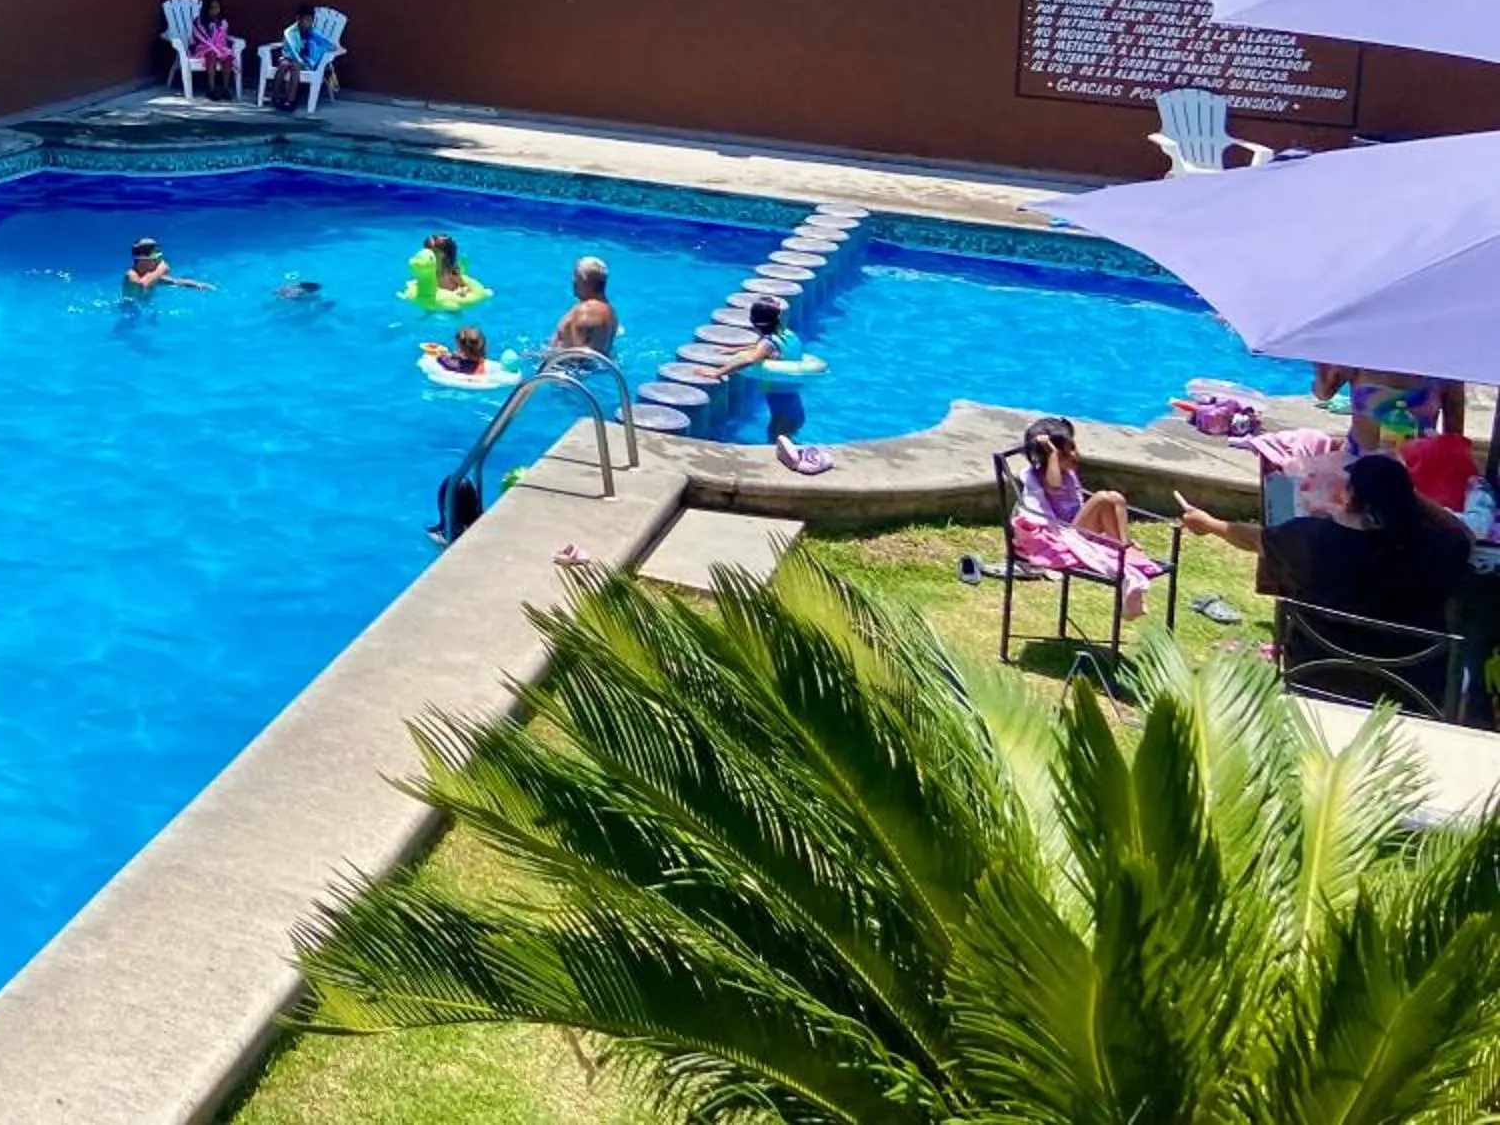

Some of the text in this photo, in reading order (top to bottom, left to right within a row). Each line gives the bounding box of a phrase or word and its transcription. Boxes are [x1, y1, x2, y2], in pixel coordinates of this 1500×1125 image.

[1033, 15, 1053, 26] NO
[1132, 23, 1199, 38] INFLABLES
[1199, 29, 1211, 40] A
[1212, 30, 1230, 42] LA
[1236, 31, 1298, 46] ALBERCA
[1034, 4, 1057, 16] POR
[1060, 6, 1106, 20] HIGIENE
[1111, 10, 1146, 22] USAR
[1151, 13, 1195, 26] TRAJE
[1031, 37, 1050, 49] NO
[1117, 44, 1129, 55] A
[1130, 45, 1146, 57] LA
[1148, 47, 1196, 62] ALBERCA
[1202, 53, 1228, 65] CON
[1231, 55, 1313, 72] BRONCEADOR
[1032, 26, 1052, 38] NO
[1116, 34, 1136, 45] SU
[1138, 36, 1181, 49] LUGAR
[1185, 40, 1213, 52] LOS
[1219, 42, 1307, 58] CAMASTROS
[1030, 61, 1045, 73] EL
[1047, 62, 1073, 74] USO
[1079, 65, 1096, 76] DE
[1096, 66, 1113, 78] LA
[1113, 68, 1171, 84] ALBERCA
[1191, 76, 1225, 89] BAJO
[1228, 78, 1245, 91] SU
[1245, 81, 1348, 101] RESPONSABILIDAD
[1031, 49, 1050, 61] NO
[1051, 51, 1098, 65] ALTERAR
[1100, 54, 1118, 67] EL
[1118, 57, 1161, 71] ORDEN
[1162, 60, 1182, 73] EN
[1224, 66, 1290, 82] PUBLICAS
[1055, 76, 1125, 97] GRACIAS
